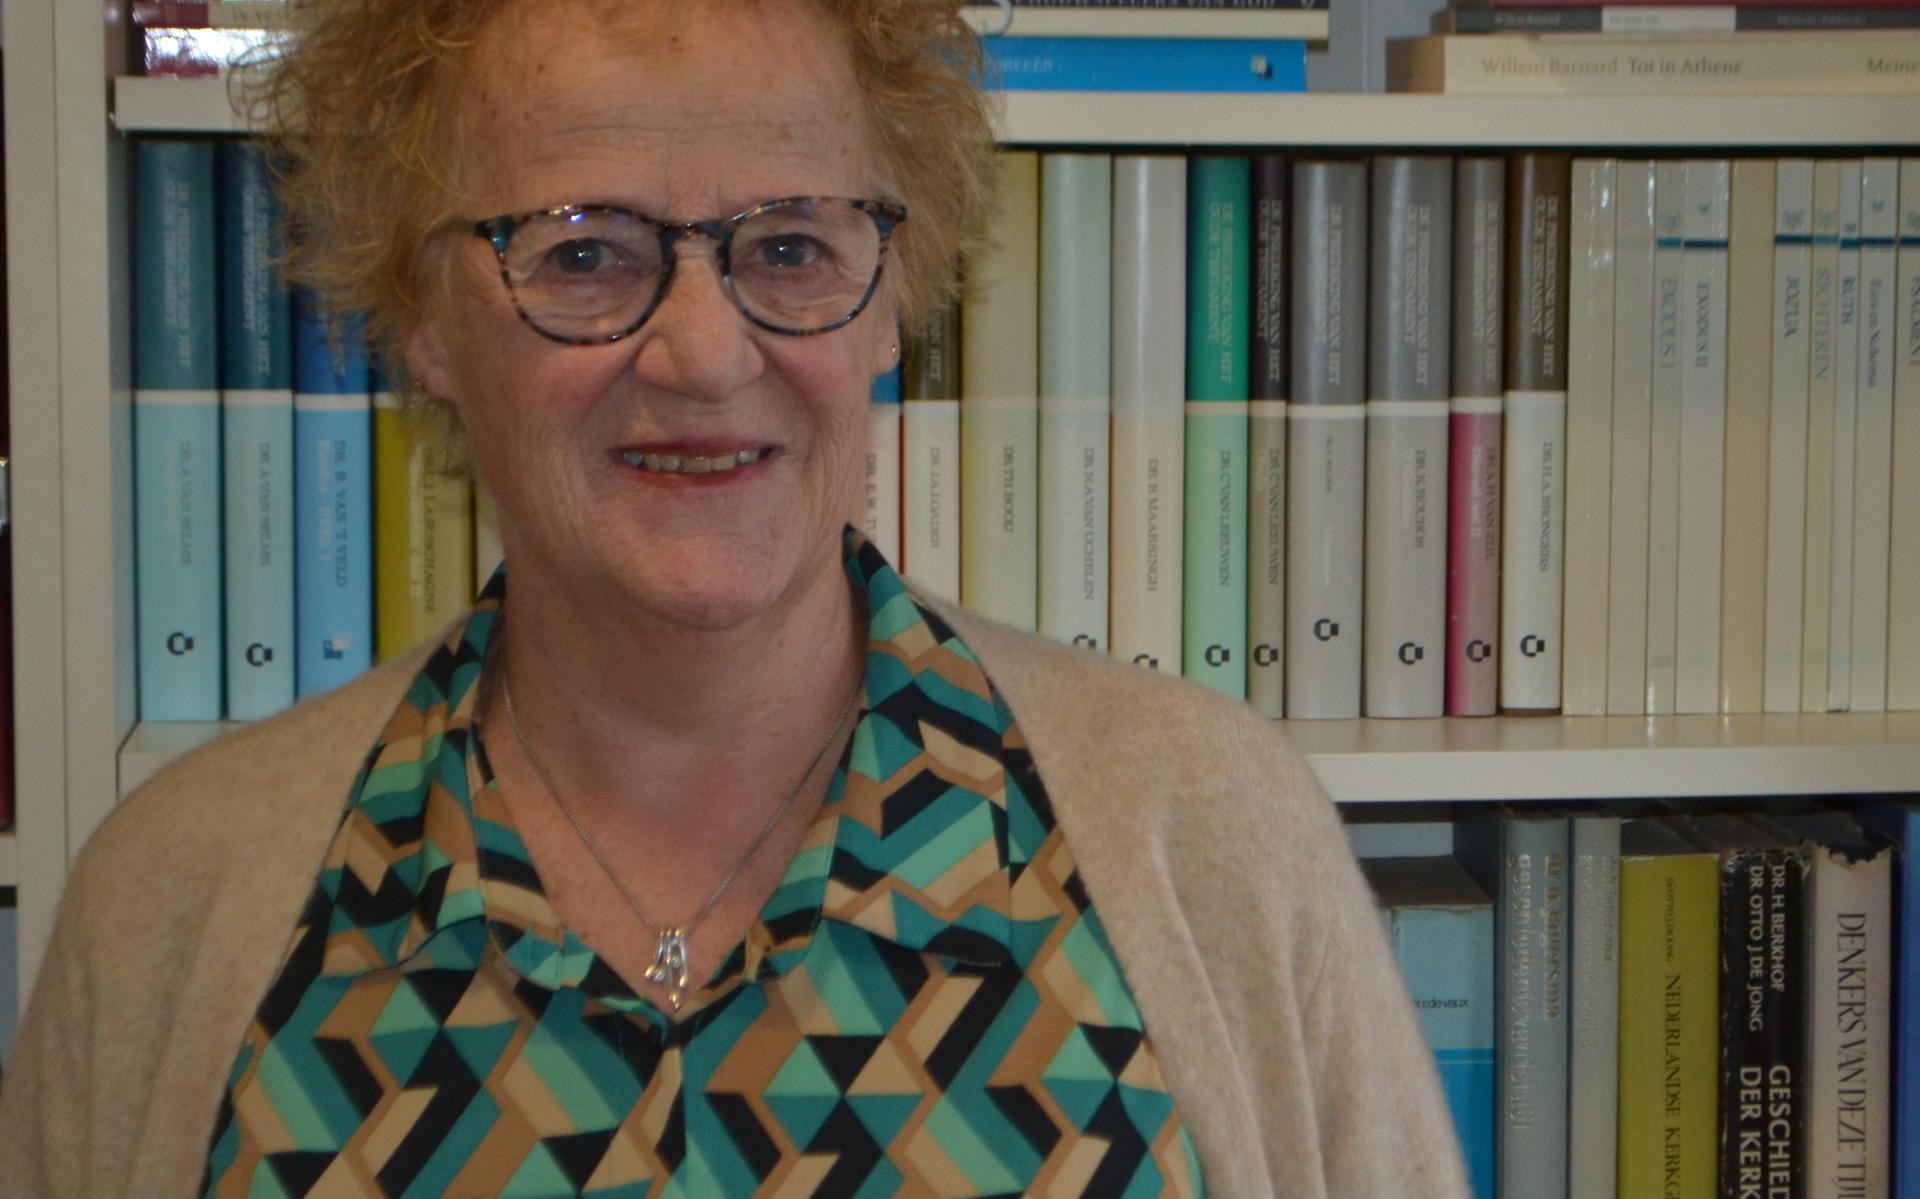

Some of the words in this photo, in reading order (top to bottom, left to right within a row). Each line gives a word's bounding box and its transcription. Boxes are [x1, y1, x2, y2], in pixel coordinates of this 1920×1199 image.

[1480, 54, 1545, 76] Willem
[1549, 55, 1619, 76] Barnard
[1658, 58, 1677, 76] in
[1679, 55, 1743, 76] Athene
[1659, 278, 1677, 358] EXODUS
[1696, 281, 1711, 353] EXODUS
[1783, 274, 1801, 339] JOZUA
[1814, 268, 1832, 381] RICHTEREN
[1841, 275, 1856, 325] RUTH
[335, 490, 347, 524] VAN
[1146, 497, 1159, 593] MAARSINGH
[1770, 865, 1785, 890] DR.
[1749, 897, 1765, 940] OTTO
[1749, 956, 1764, 979] DE
[1769, 912, 1785, 993] BERKHOF
[1837, 912, 1867, 1034] DENKERS
[1746, 983, 1764, 1032] JONG
[1665, 974, 1682, 1117] NEDERLANDSE
[1837, 1040, 1867, 1085] VAN
[1740, 1066, 1762, 1122] DER
[1837, 1088, 1867, 1153] DEZE
[1665, 1127, 1681, 1199] KERKG
[1768, 1064, 1791, 1199] GESCHIED
[1740, 1130, 1761, 1199] KERK
[1831, 1161, 1867, 1199] TIJ
